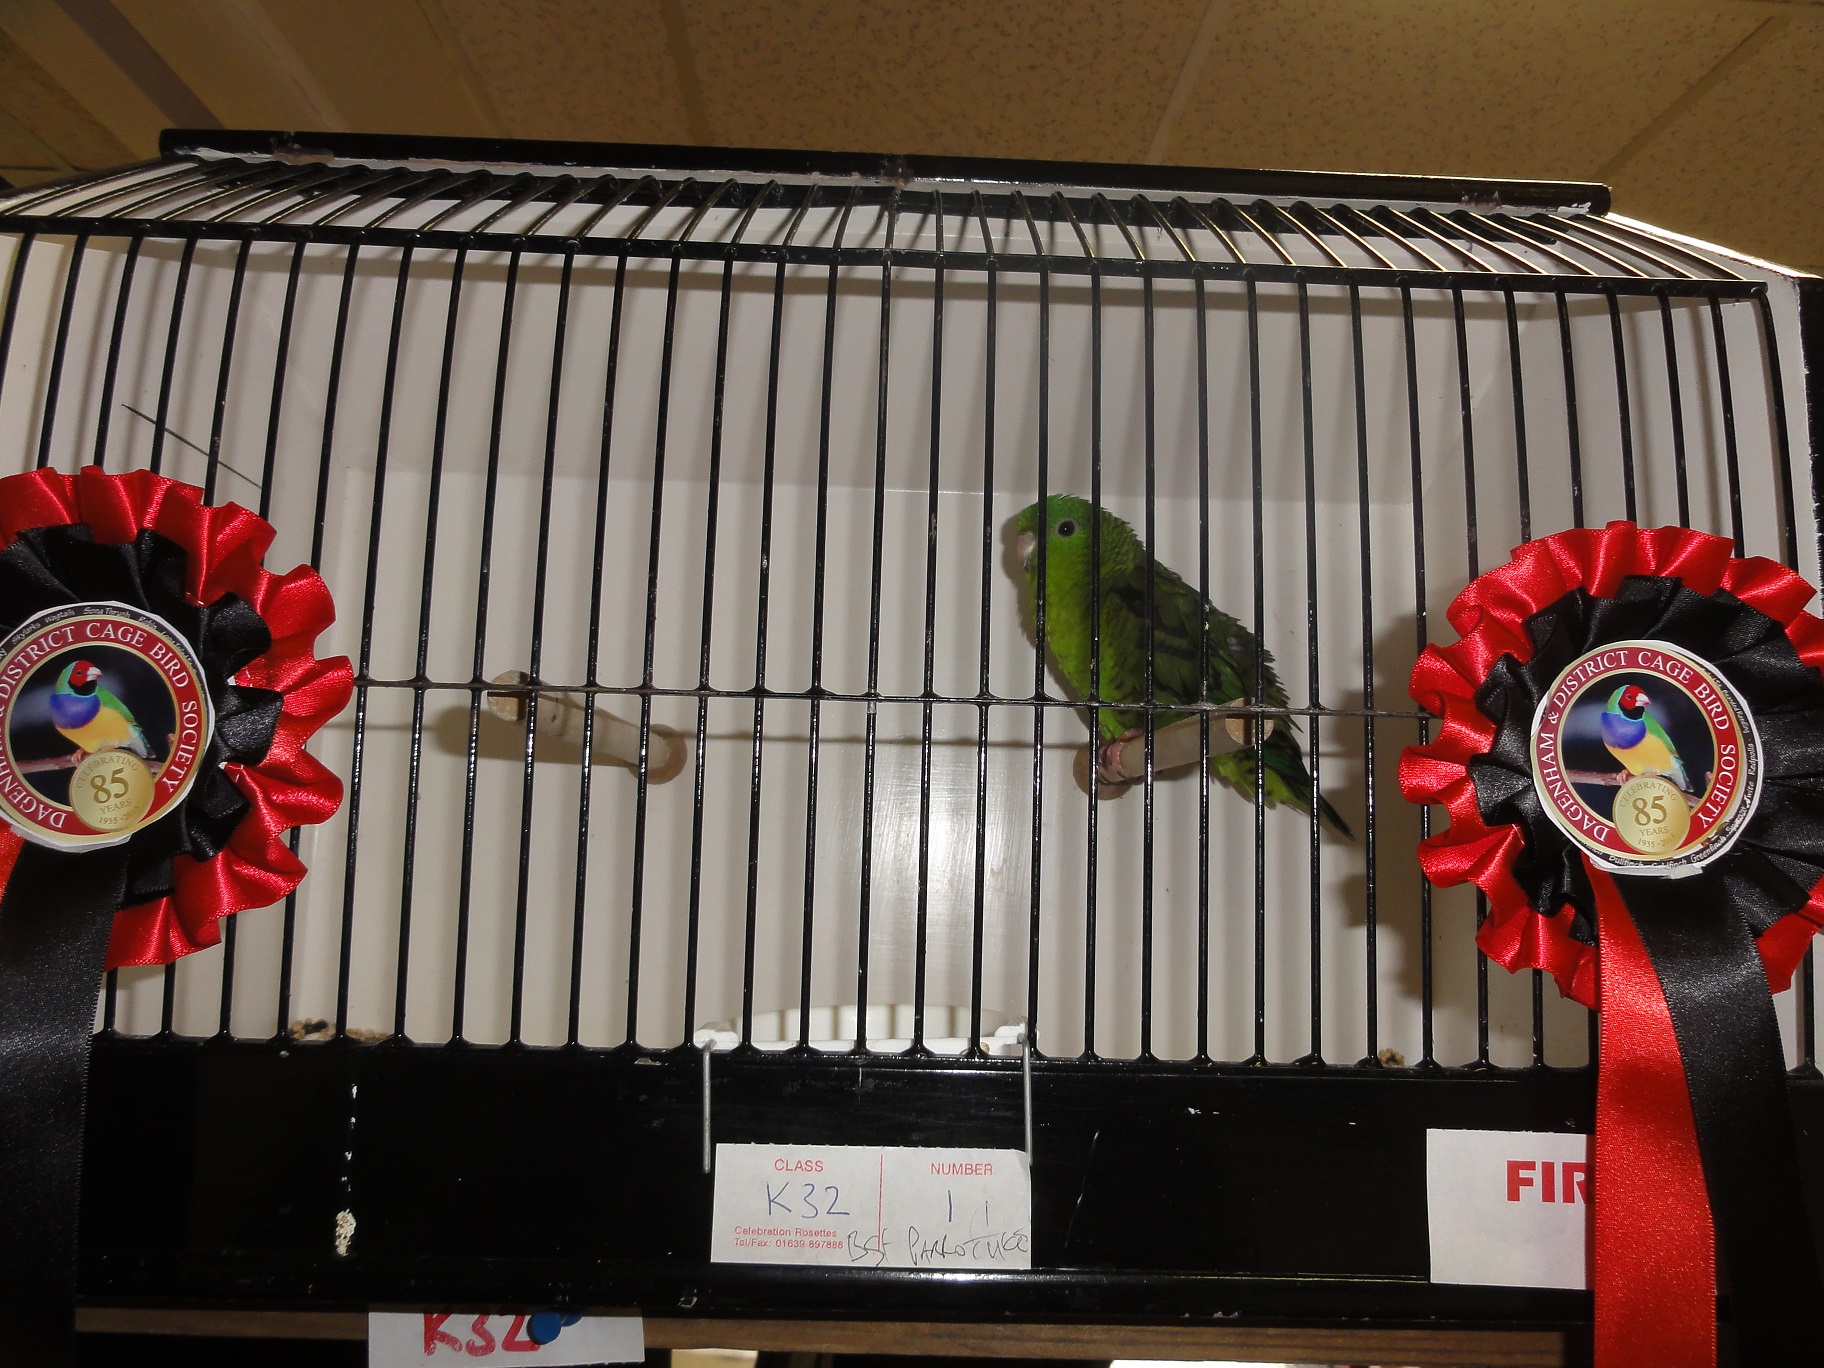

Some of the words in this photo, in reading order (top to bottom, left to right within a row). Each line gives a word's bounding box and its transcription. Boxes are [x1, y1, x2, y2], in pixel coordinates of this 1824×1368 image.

[86, 622, 147, 648] CAGE
[0, 626, 75, 700] DISTRICT
[149, 642, 189, 688] BIRD
[1554, 650, 1628, 709] DISTRICT
[1638, 651, 1693, 685] CAGE
[1548, 712, 1559, 724] &
[1693, 682, 1729, 730] BIRD
[162, 700, 199, 794] SOCIETY
[0, 724, 68, 829] DAGENH
[76, 755, 139, 789] CELEBRATING
[90, 767, 129, 804] 85
[1539, 732, 1610, 842] DAGENHAM
[1697, 744, 1736, 829] SOCIETY
[100, 799, 133, 815] YEARS
[1619, 781, 1677, 807] CELEBRATING
[1632, 795, 1667, 826] 85
[1639, 826, 1669, 836] YEARS
[774, 1157, 824, 1173] CLASS
[930, 1162, 993, 1176] NUMBER
[734, 1225, 791, 1238] Celebration
[794, 1227, 837, 1239] Rosettes
[734, 1237, 771, 1249] Tel/Fax:
[775, 1238, 805, 1249] 01639
[808, 1239, 844, 1250] 897888
[423, 1313, 541, 1357] K32
